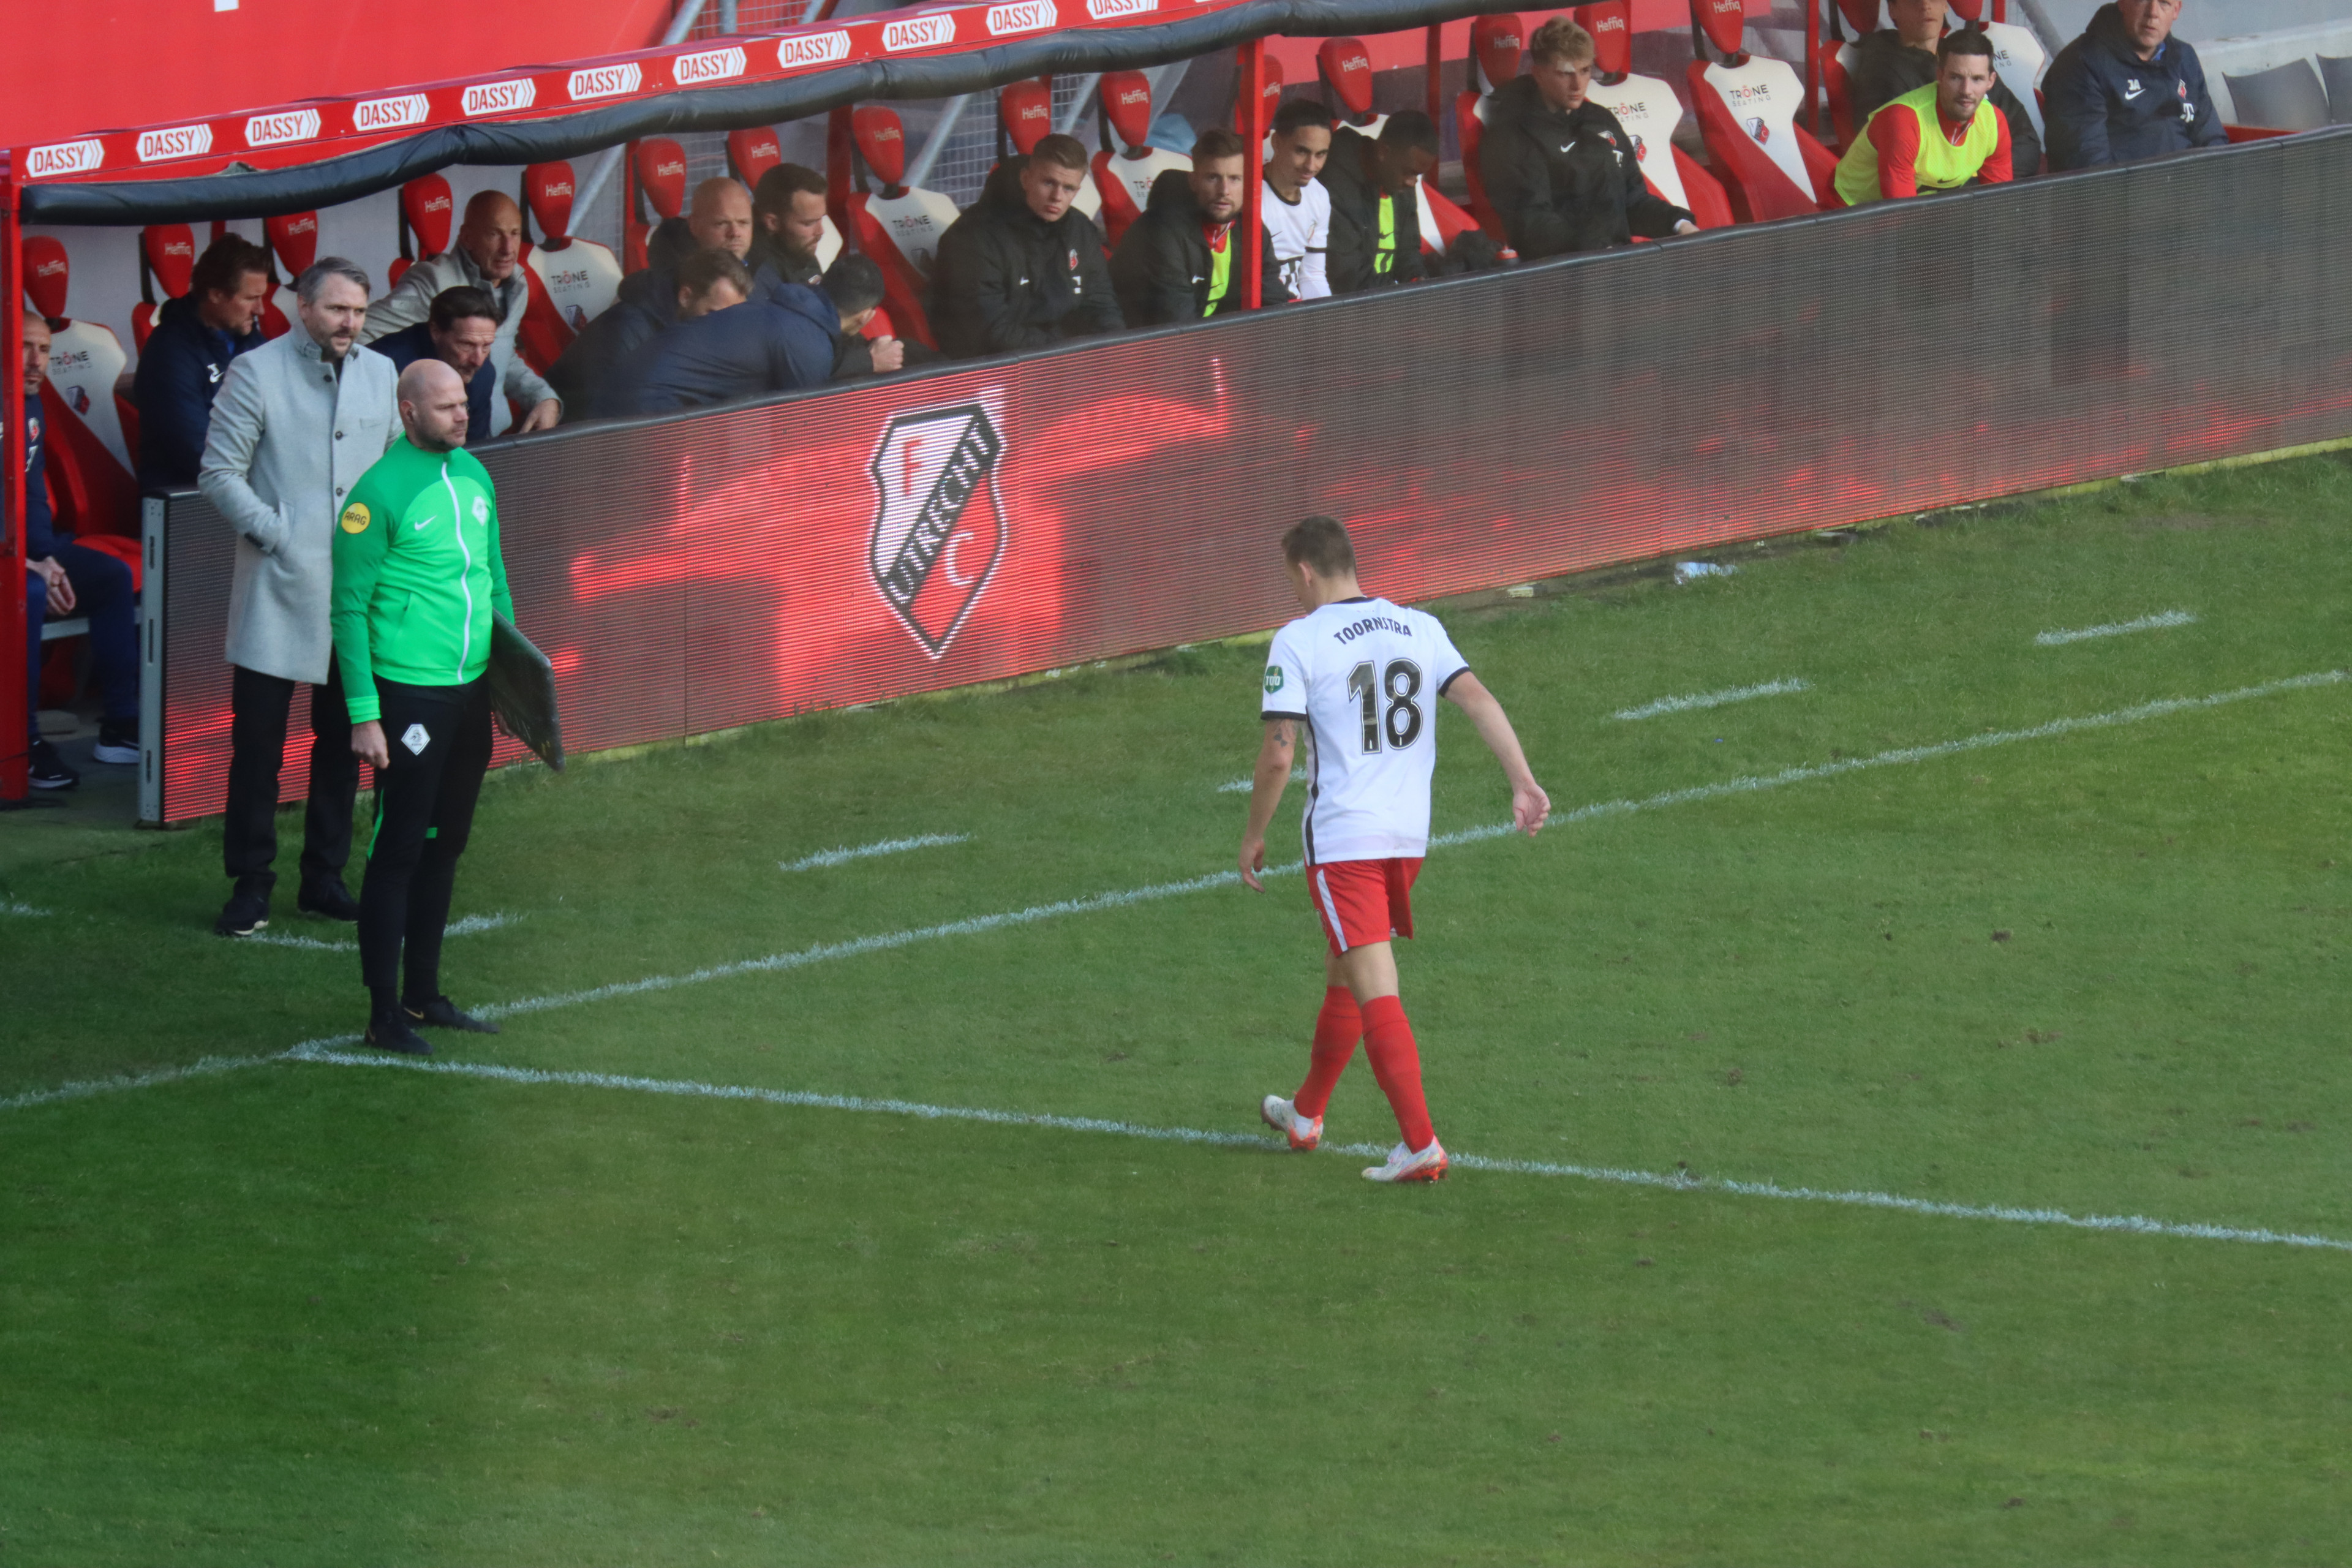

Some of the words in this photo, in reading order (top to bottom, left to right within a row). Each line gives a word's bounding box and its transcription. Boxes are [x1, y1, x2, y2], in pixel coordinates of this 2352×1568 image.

[993, 3, 1042, 31] DASSY
[1597, 17, 1624, 32] Heffiq
[889, 19, 939, 47] DASSY
[1494, 34, 1520, 50] Heffiq
[785, 36, 834, 64] DASSY
[680, 52, 730, 80] DASSY
[1343, 56, 1369, 72] Heffiq
[575, 67, 625, 96] DASSY
[1262, 82, 1281, 97] effiq
[469, 83, 519, 111] DASSY
[1121, 89, 1148, 105] Heffiq
[1732, 94, 1771, 107] SEATING
[360, 99, 412, 127] DASSY
[1022, 104, 1048, 120] Heffiq
[1618, 111, 1649, 123] ATING
[253, 114, 303, 142] DASSY
[873, 126, 900, 142] Heffiq
[144, 129, 195, 157] DASSY
[752, 143, 778, 159] Heffiq
[34, 146, 86, 173] DASSY
[657, 161, 684, 177] Heffiq
[546, 183, 572, 198] Heffiq
[425, 196, 451, 213] Heffiq
[902, 437, 922, 495] F
[345, 511, 367, 526] ARAG
[888, 421, 990, 605] UTRECHT
[946, 531, 974, 586] C
[1333, 617, 1412, 645] TOORNSTRA
[1347, 657, 1423, 755] 18
